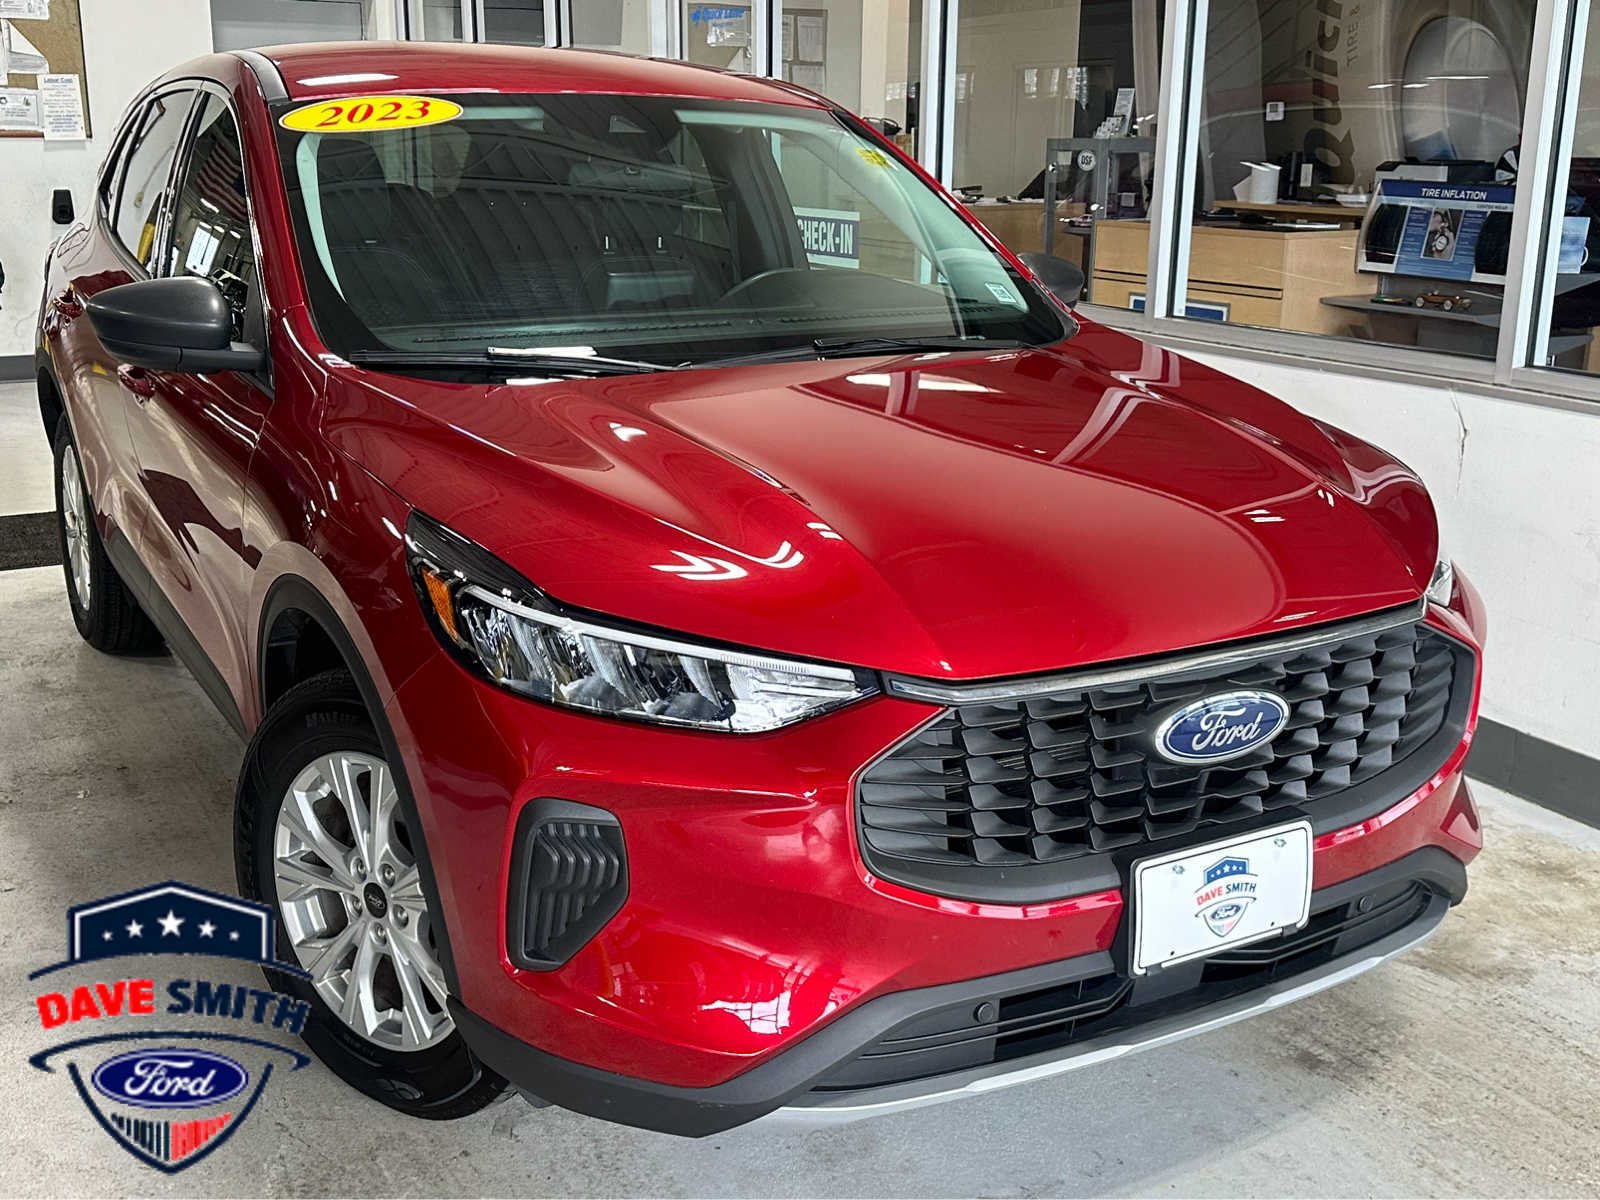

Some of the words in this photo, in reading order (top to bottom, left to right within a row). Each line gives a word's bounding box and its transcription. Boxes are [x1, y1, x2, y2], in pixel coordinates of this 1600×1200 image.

[316, 100, 431, 127] 2023
[1421, 187, 1440, 197] TIRE
[1441, 189, 1487, 200] INFLATION
[1191, 707, 1263, 751] Ford
[1196, 886, 1224, 906] DAVE
[1225, 882, 1257, 894] SMITH
